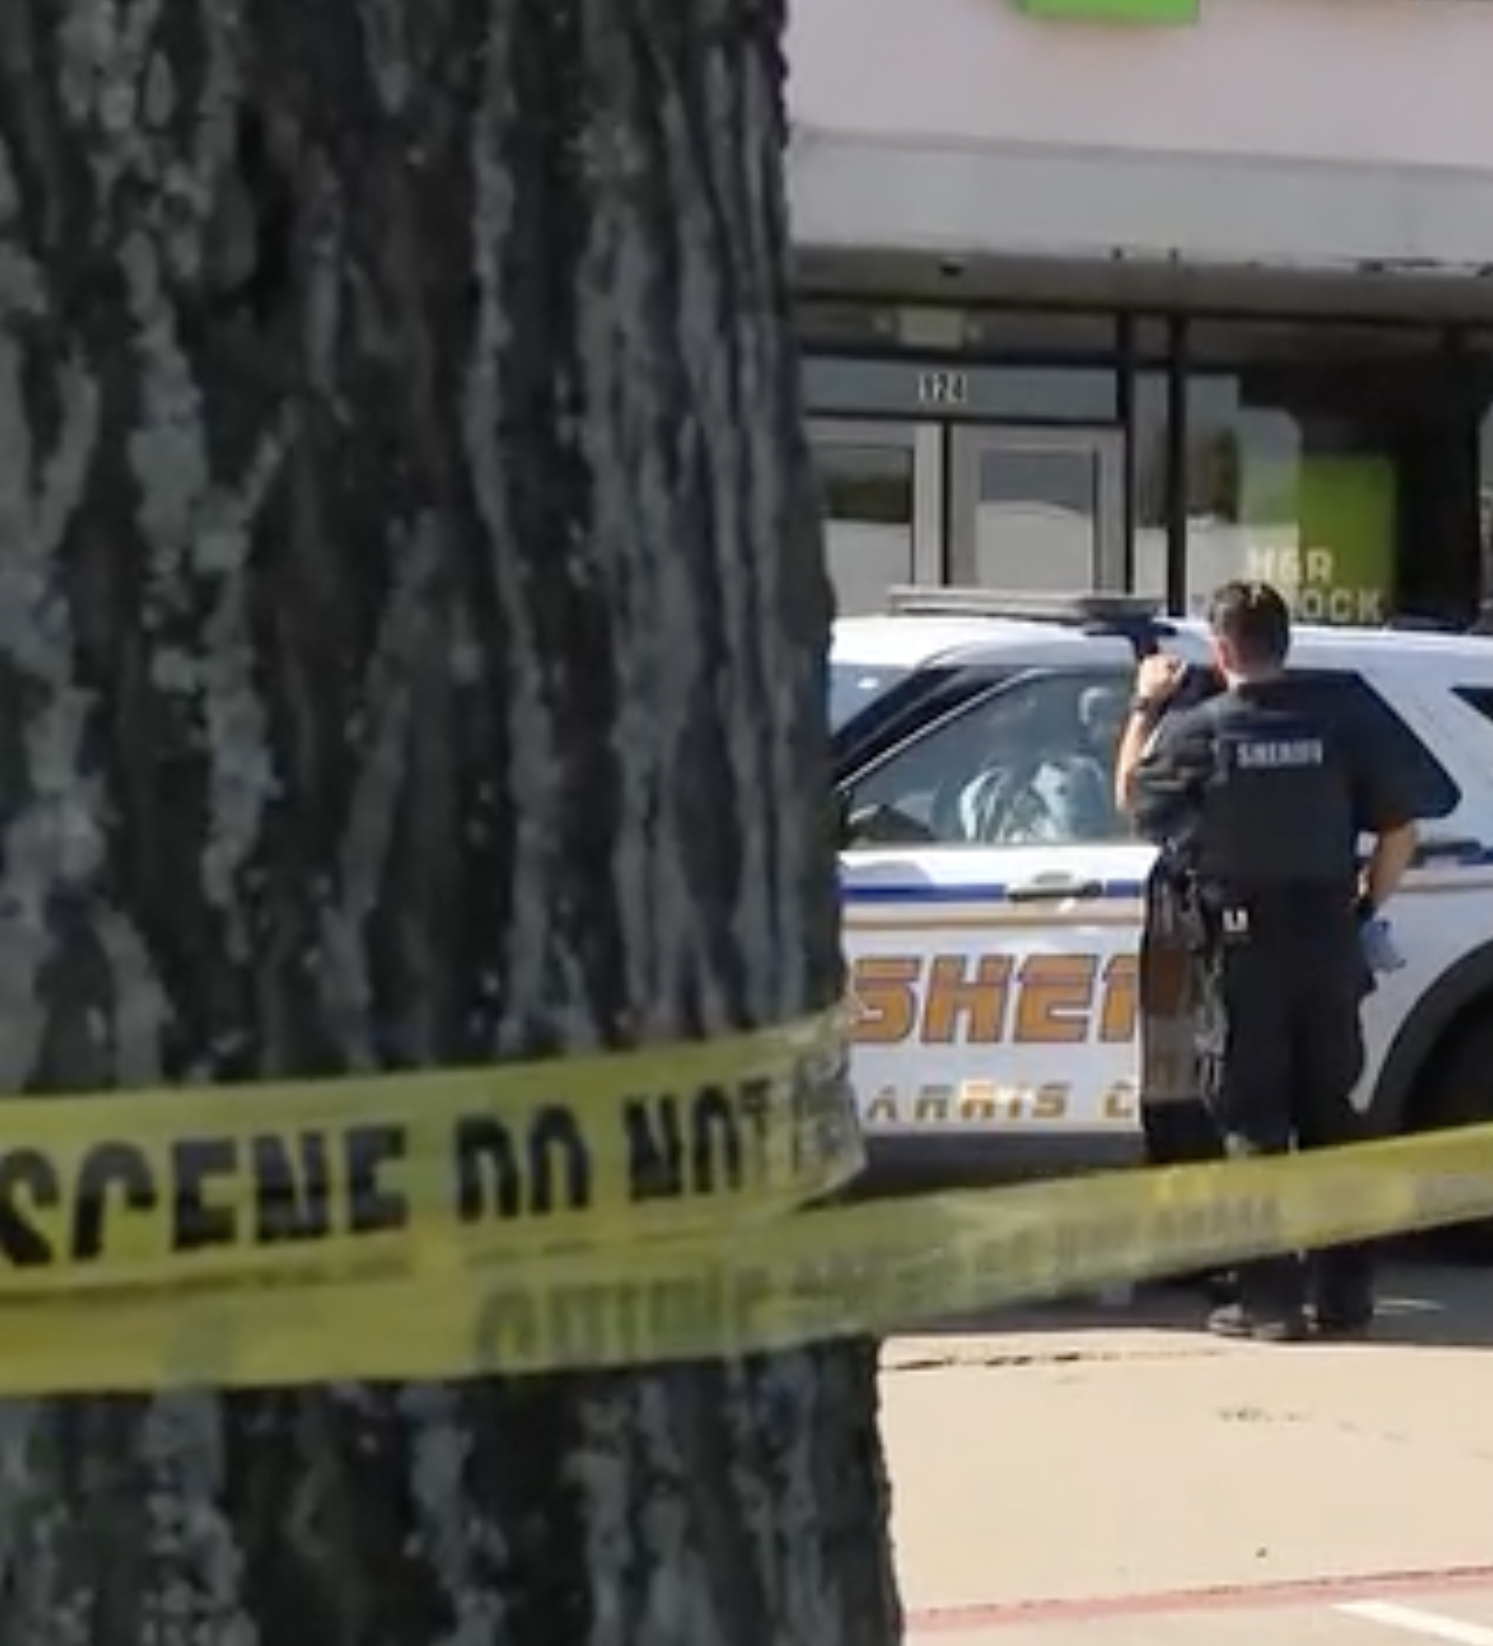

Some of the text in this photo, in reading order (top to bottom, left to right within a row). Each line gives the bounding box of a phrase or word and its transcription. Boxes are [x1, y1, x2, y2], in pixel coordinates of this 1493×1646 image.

[1298, 588, 1383, 623] OCK
[866, 1080, 1073, 1122] ARRIS
[453, 1103, 591, 1221] DO
